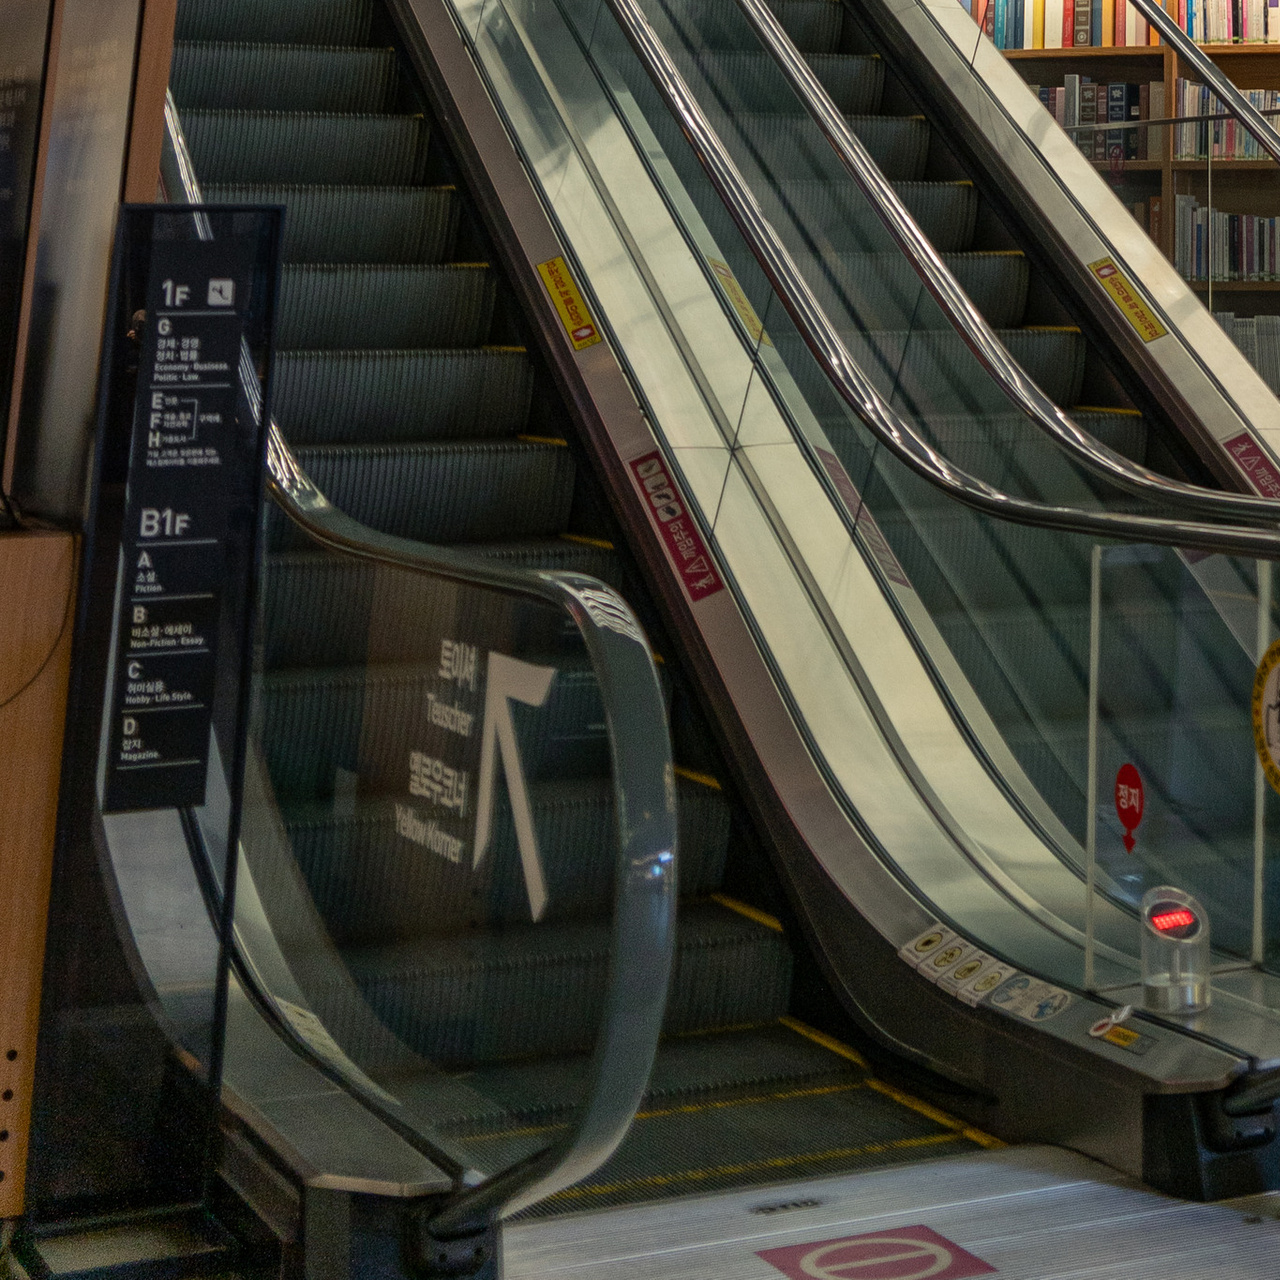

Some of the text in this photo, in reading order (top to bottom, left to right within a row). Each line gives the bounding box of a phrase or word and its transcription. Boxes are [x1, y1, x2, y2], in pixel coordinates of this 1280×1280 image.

[162, 278, 191, 307] 1F
[157, 318, 172, 336] G
[154, 361, 229, 373] Economy Business
[153, 372, 200, 382] Politic Law
[151, 391, 164, 410] E
[150, 411, 162, 429] F
[148, 430, 161, 448] H
[139, 507, 191, 538] B1F
[137, 549, 152, 569] A
[136, 570, 157, 584] 소설
[135, 583, 163, 594] Fiction
[133, 604, 147, 624] B
[130, 636, 205, 649] Non-Fiction Essay
[127, 661, 143, 680] C
[126, 691, 193, 705] Hobby Life Style
[123, 718, 137, 736] D
[120, 750, 160, 762] Magazine
[1118, 784, 1140, 813] 정지
